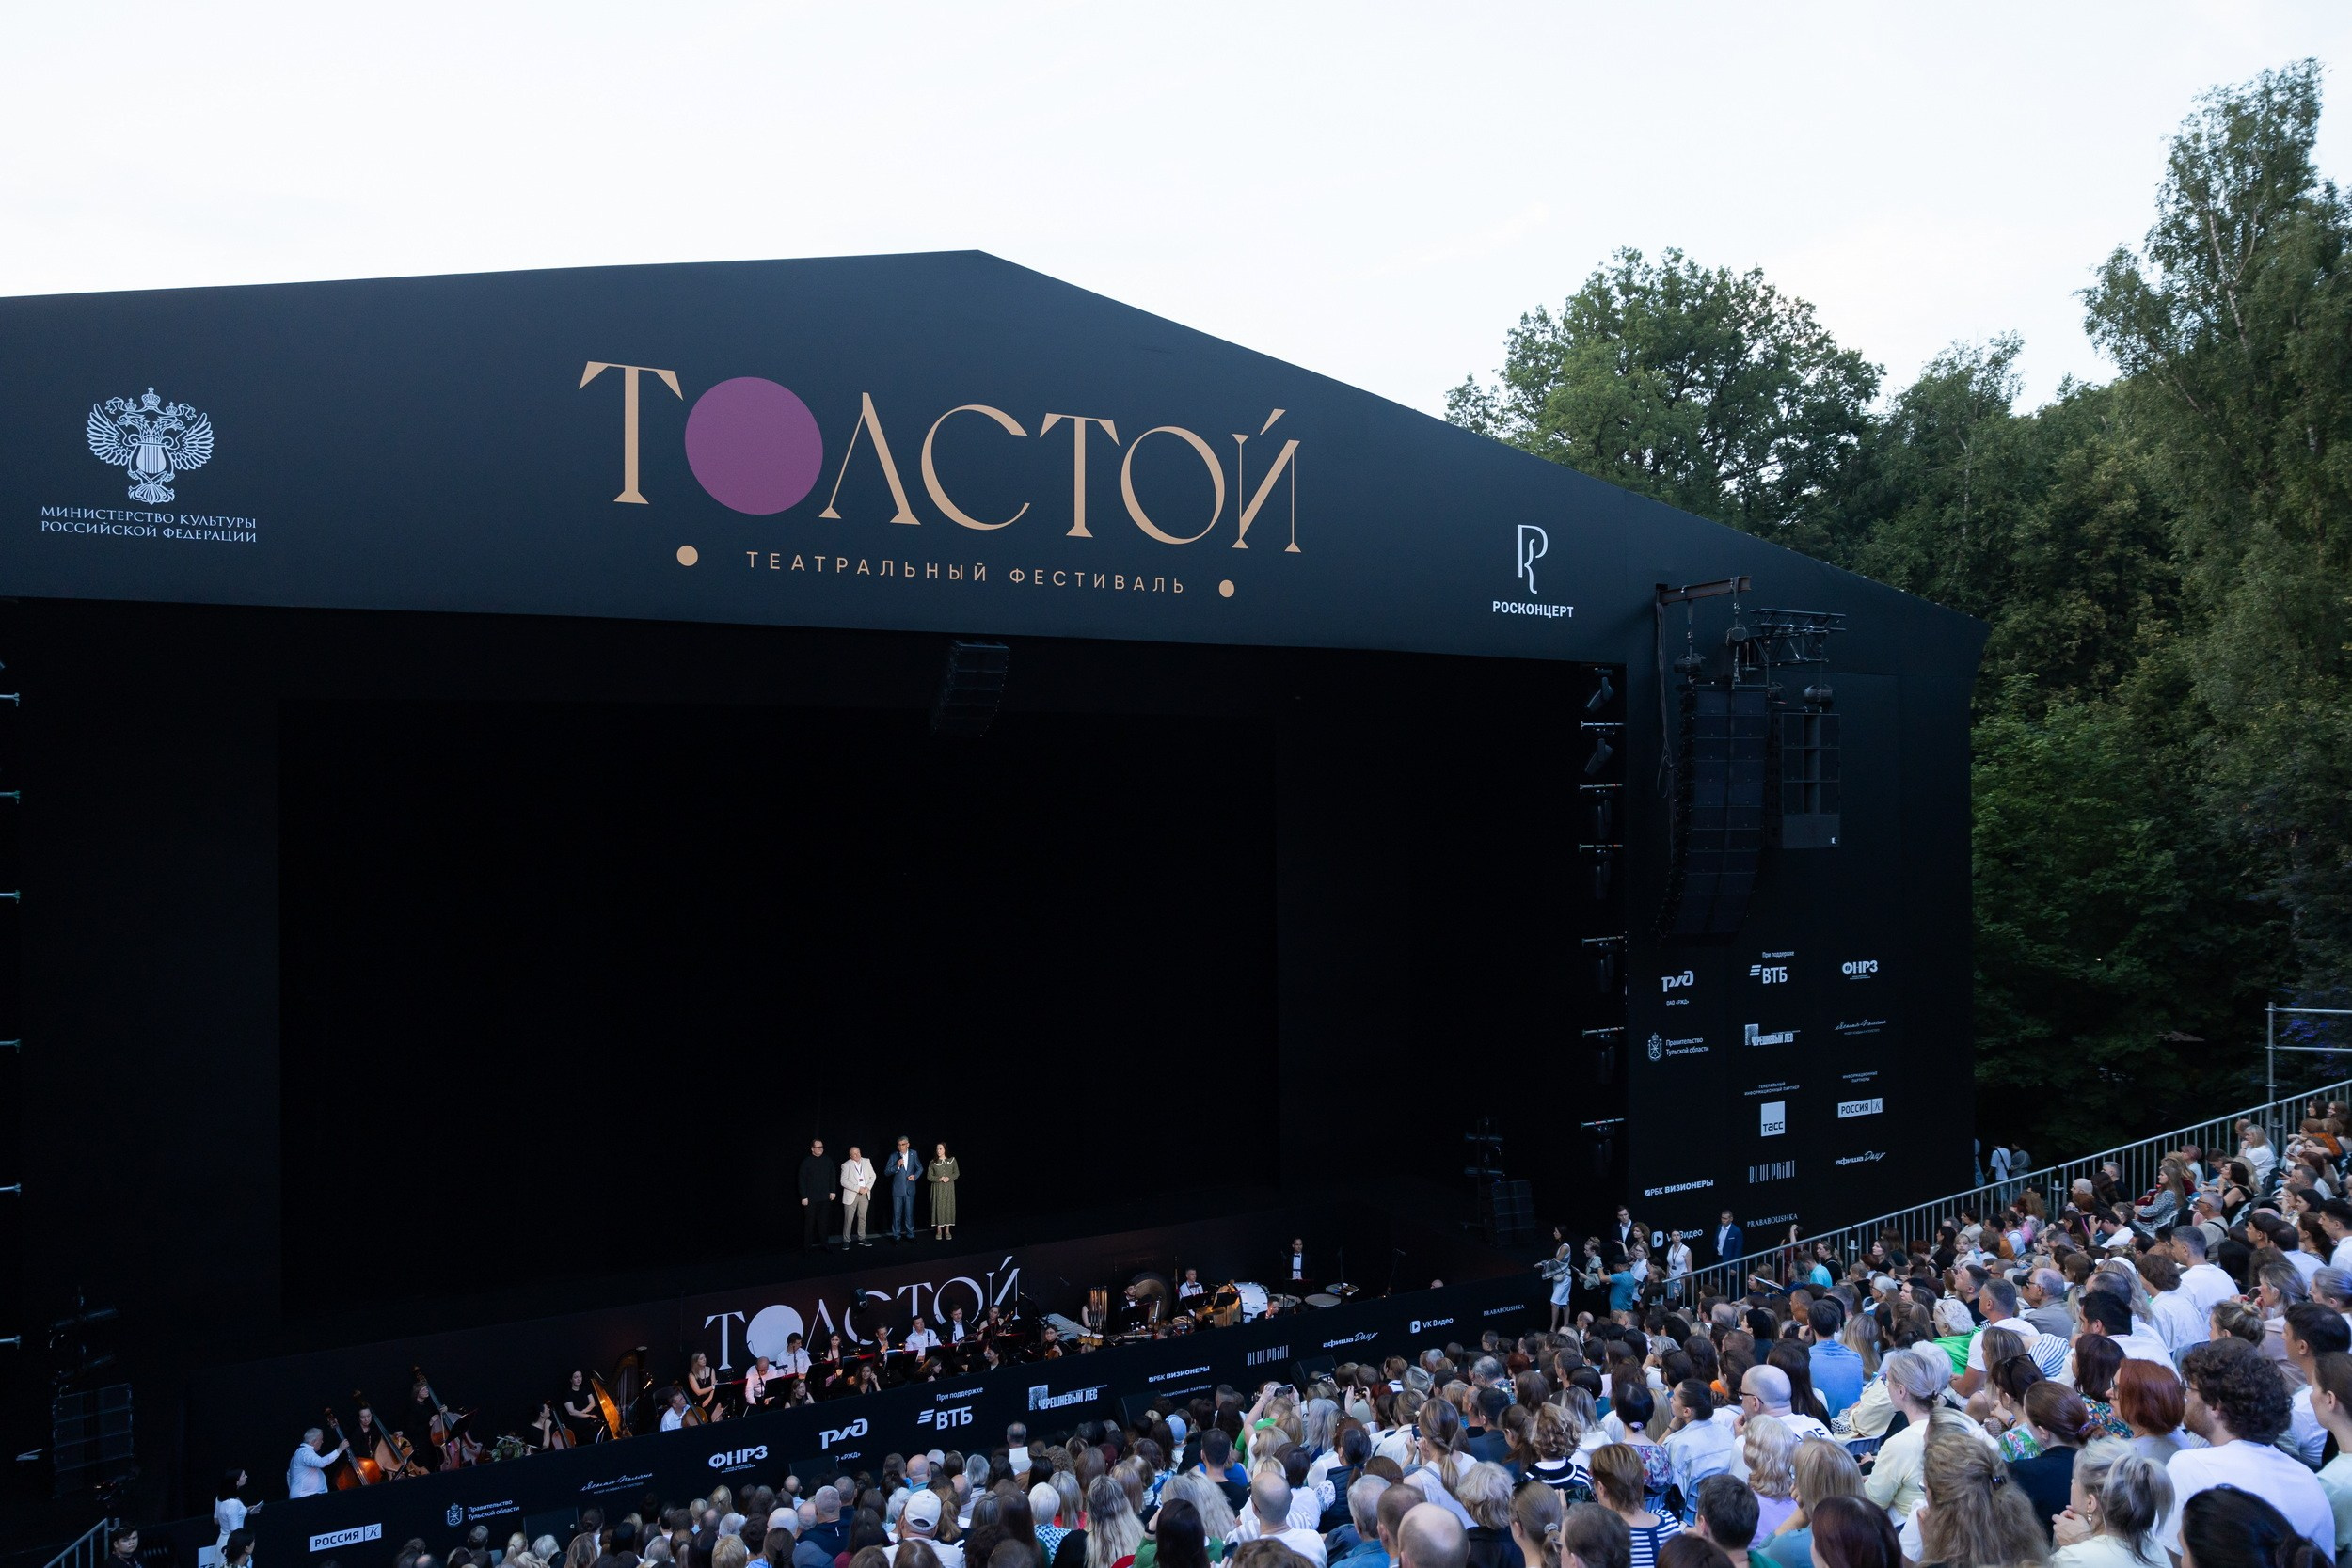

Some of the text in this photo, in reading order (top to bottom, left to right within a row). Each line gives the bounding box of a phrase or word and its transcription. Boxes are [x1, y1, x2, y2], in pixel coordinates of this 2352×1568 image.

[579, 361, 1301, 553] ТОЛСТОЙ
[40, 505, 257, 529] МИНИСТЕРСТВО КУЛЬТУРЫ
[40, 520, 257, 543] РОССИЙСКОЙ ФЕДЕРАЦИИ
[746, 551, 1184, 594] ТЕАТРАЛЬНЫЙ ФЕСТИВАЛЬ
[1492, 600, 1574, 618] РОСКОНЦЕРТ
[1762, 966, 1788, 984] ВТБ
[1666, 1037, 1704, 1047] Правительство
[1665, 1047, 1689, 1056] Тульской
[1841, 1102, 1869, 1115] РОССИЯ
[1650, 1179, 1714, 1196] РБК ВИЗИОНЕРЫ
[1747, 1213, 1798, 1227] PRABABOUSHKA
[1483, 1304, 1525, 1317] PRABABOUSHKA
[1422, 1318, 1454, 1329] VK Видео
[1166, 1365, 1210, 1379] ВИЗИОНЕРЫ
[936, 1386, 984, 1402] При поддержке
[1038, 1389, 1084, 1410] ЧЕРЕШНЕВЫЙ
[1085, 1388, 1098, 1402] ЛЕС
[936, 1405, 973, 1430] ВТБ
[468, 1499, 513, 1513] Правительство
[468, 1506, 520, 1521] Тульской области
[314, 1530, 359, 1547] РОССИЯ
